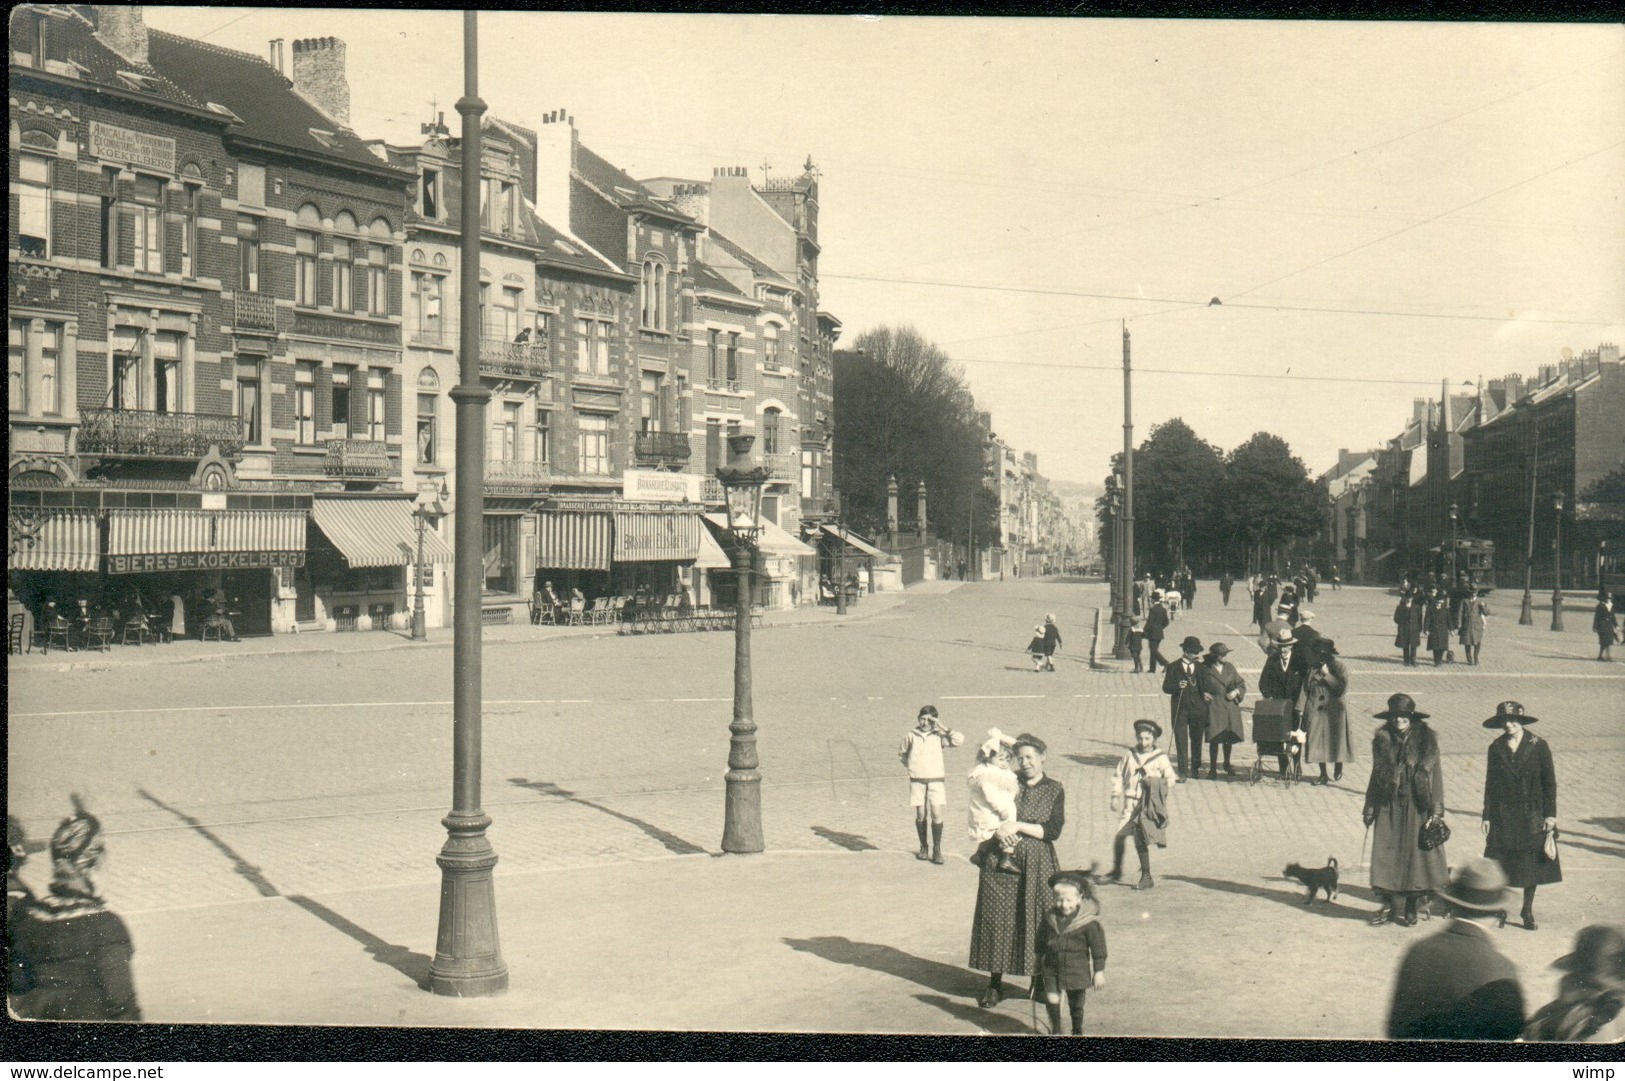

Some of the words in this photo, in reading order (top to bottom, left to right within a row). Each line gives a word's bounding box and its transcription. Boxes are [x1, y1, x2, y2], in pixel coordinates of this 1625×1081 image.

[97, 146, 172, 169] KOEKELBERG
[116, 554, 178, 571] BIERES
[182, 555, 195, 567] DE
